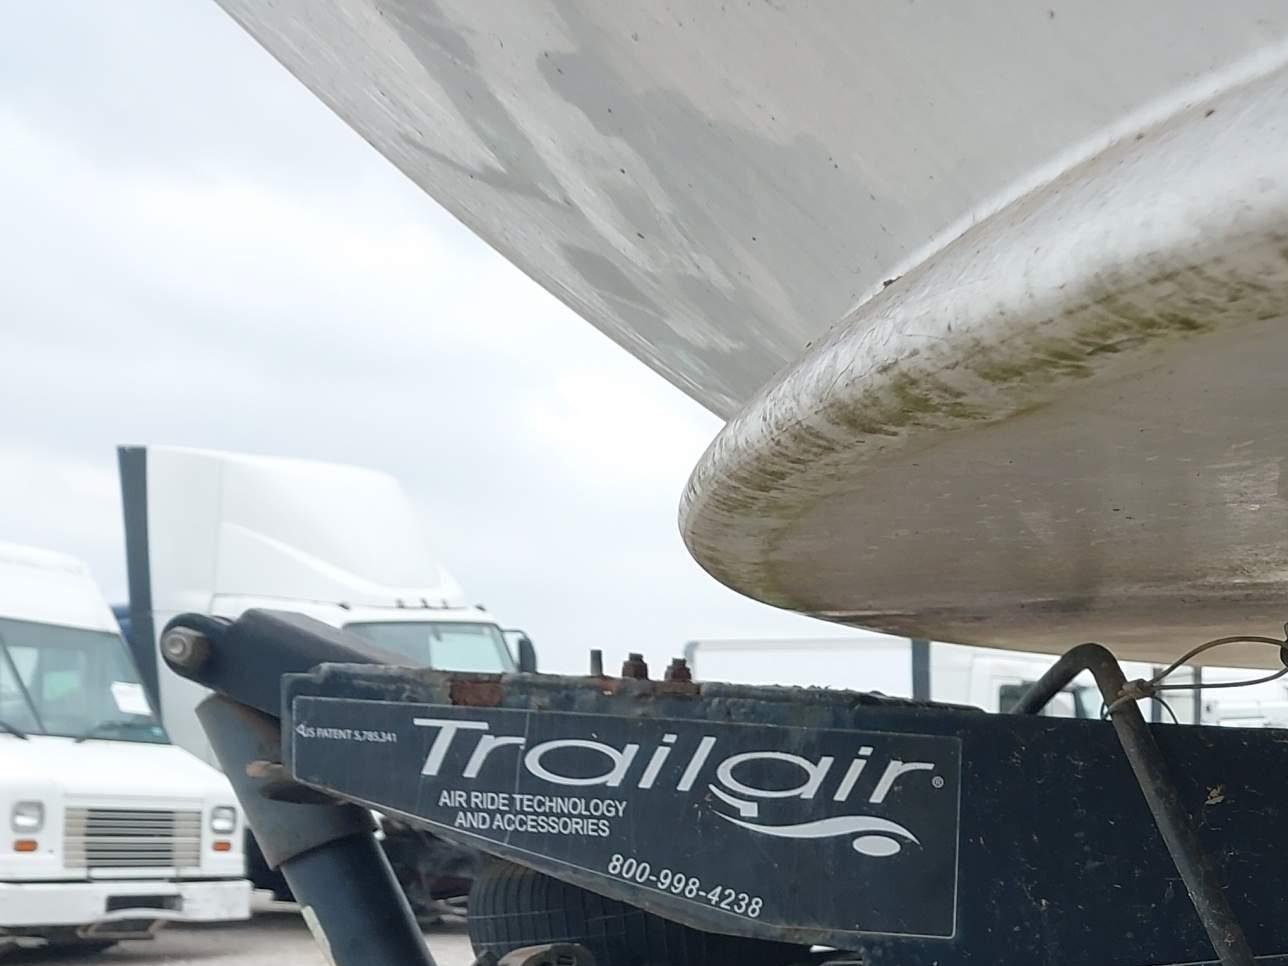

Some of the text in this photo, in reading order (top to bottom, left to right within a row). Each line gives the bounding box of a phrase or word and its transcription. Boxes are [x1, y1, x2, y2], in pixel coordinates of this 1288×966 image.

[316, 727, 352, 741] PATENT
[438, 790, 628, 818] AIR RIDE TECHNOLOGY
[454, 811, 611, 838] AND ACCESSORIES
[607, 853, 765, 920] 800-998-4238
